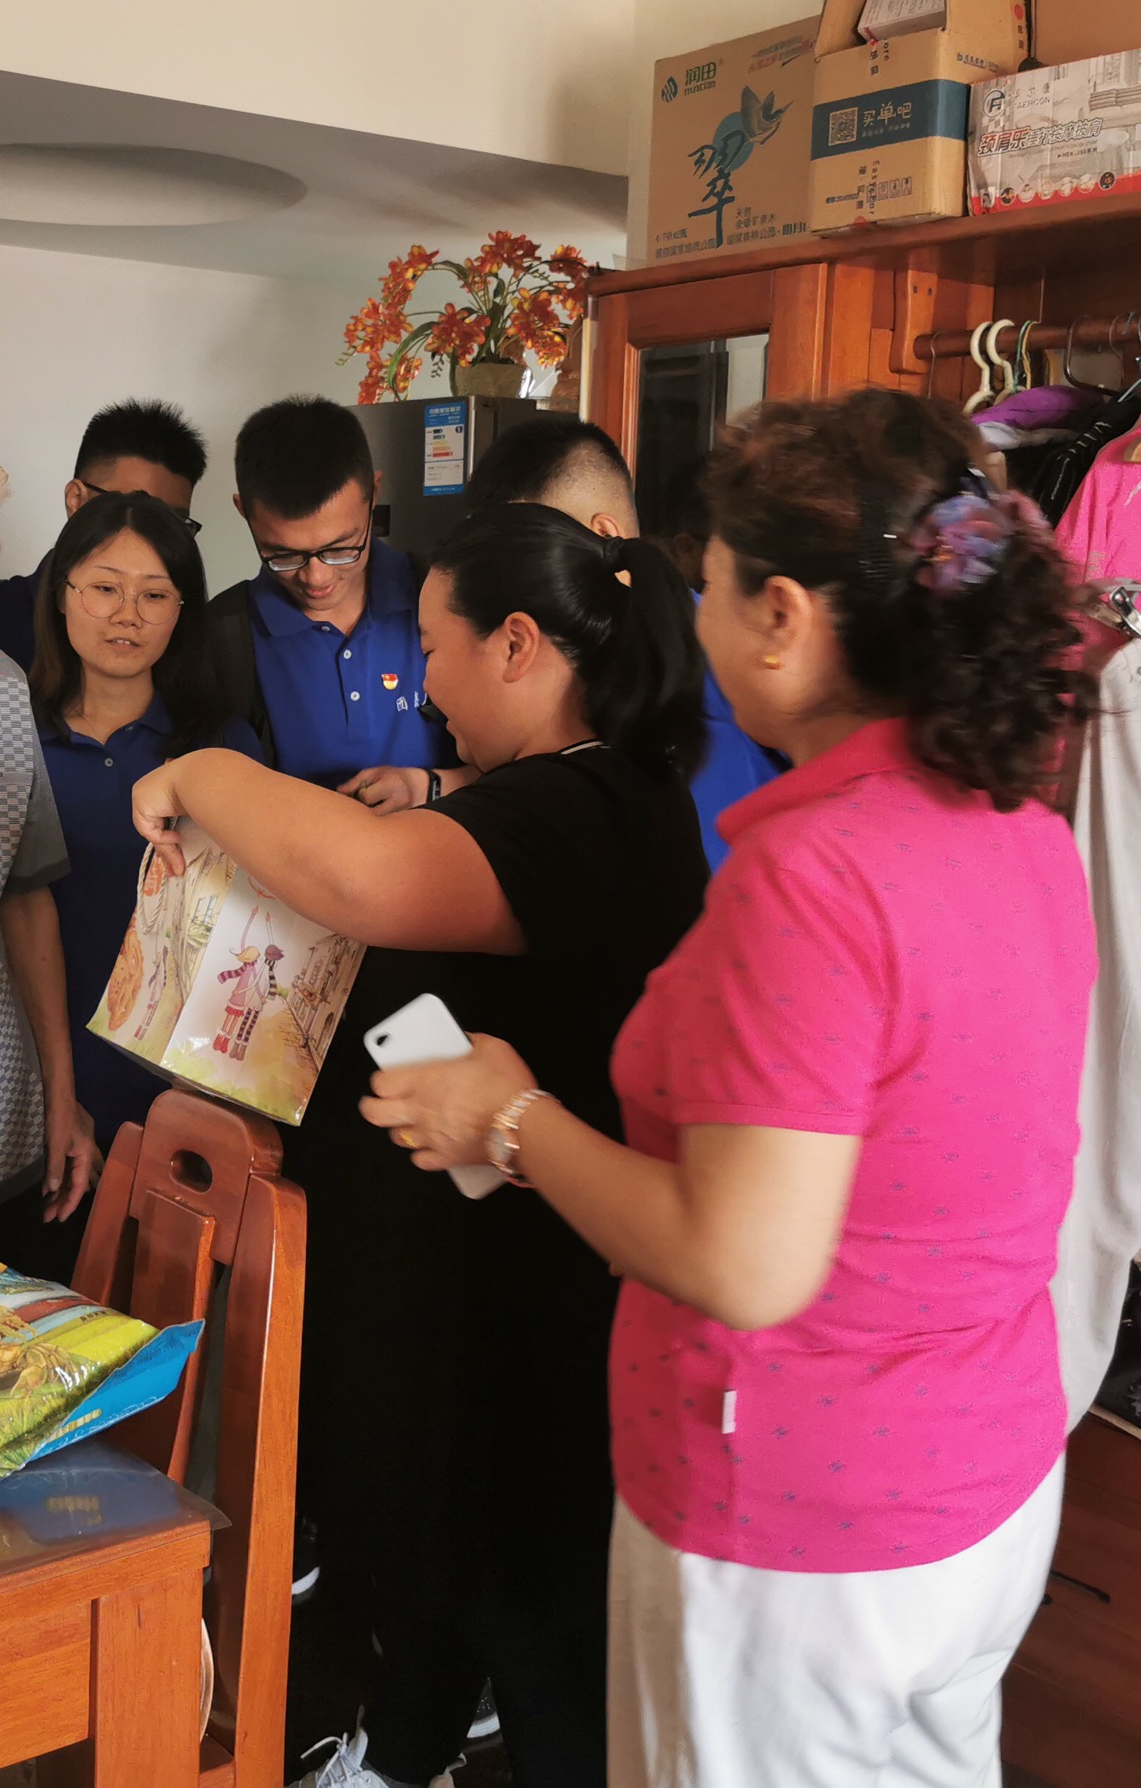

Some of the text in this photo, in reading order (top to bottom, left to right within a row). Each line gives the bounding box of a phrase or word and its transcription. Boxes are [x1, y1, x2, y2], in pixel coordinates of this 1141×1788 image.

[685, 61, 717, 86] 润田
[862, 101, 913, 128] 买单吧
